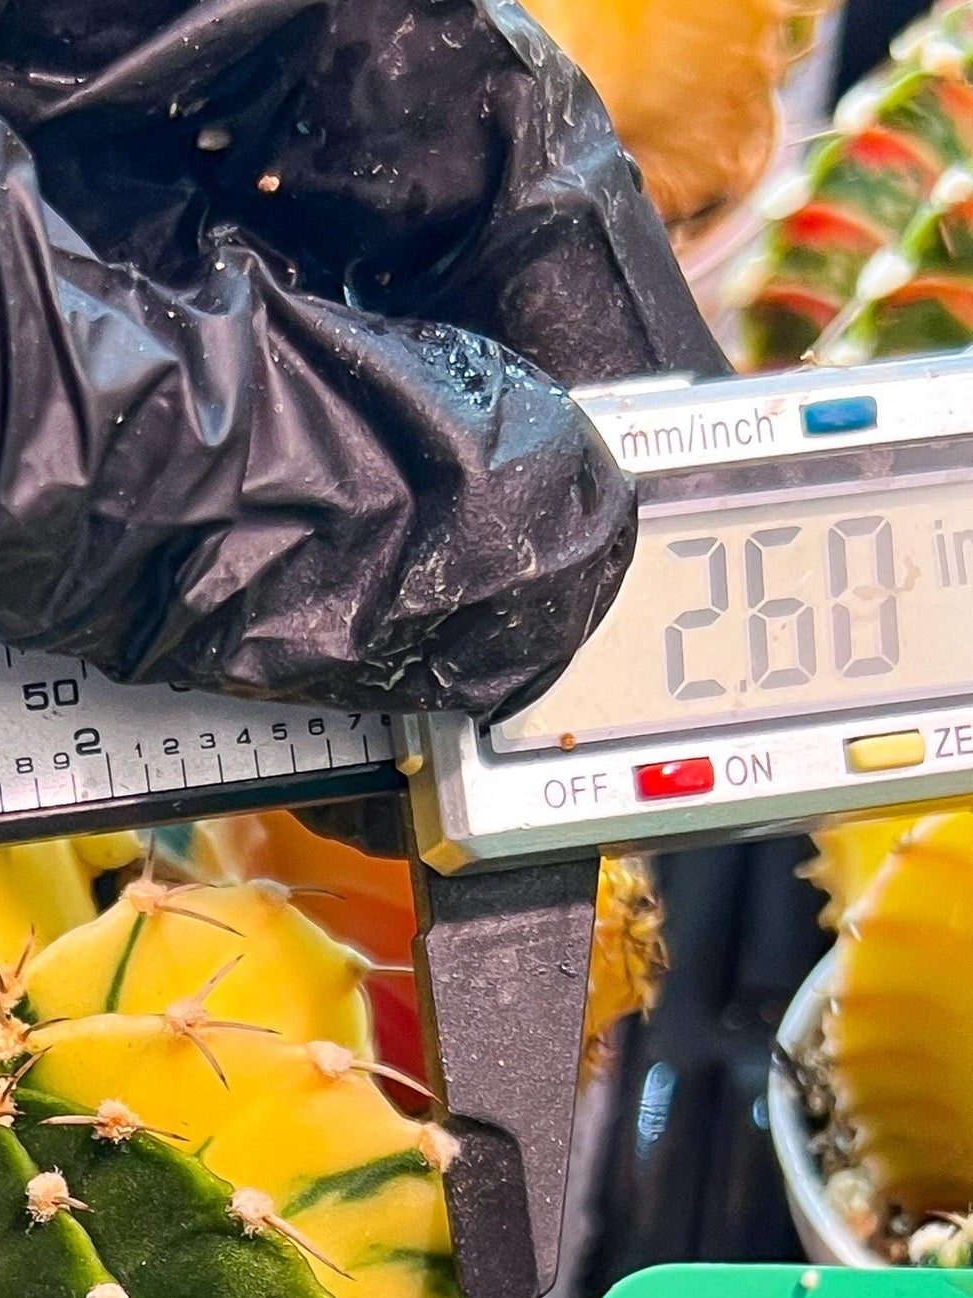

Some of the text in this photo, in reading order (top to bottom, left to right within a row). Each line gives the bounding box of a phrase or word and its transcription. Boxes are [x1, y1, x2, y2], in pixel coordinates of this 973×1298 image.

[620, 407, 775, 460] mm/inch
[21, 678, 80, 711] 50
[15, 756, 34, 775] 8
[52, 751, 71, 770] 9
[73, 727, 102, 756] 2
[134, 742, 143, 759] 1
[162, 737, 180, 756] 2
[199, 732, 216, 750] 3
[236, 727, 252, 745] 4
[271, 722, 288, 741] 5
[307, 717, 326, 736] 6
[347, 712, 362, 730] 7
[544, 773, 608, 809] OFF
[725, 752, 773, 786] ON
